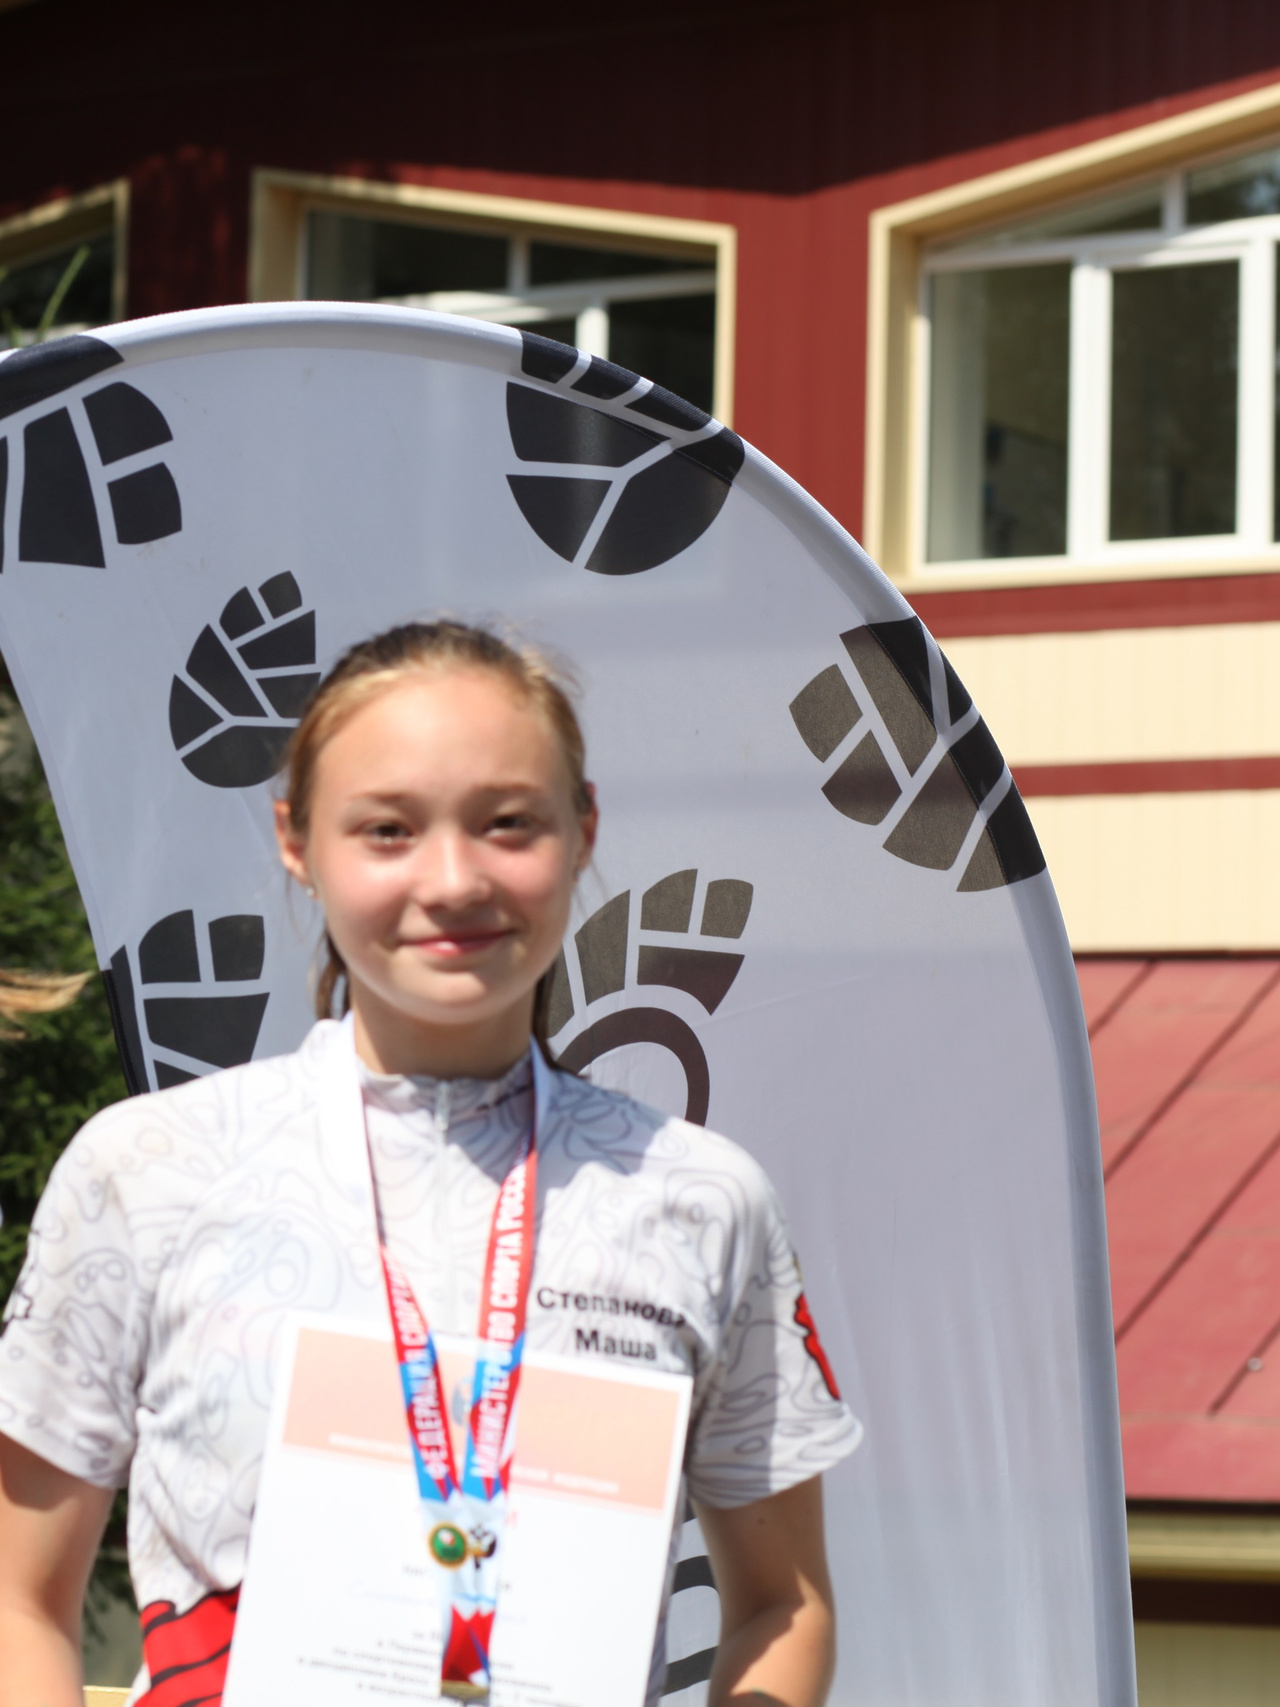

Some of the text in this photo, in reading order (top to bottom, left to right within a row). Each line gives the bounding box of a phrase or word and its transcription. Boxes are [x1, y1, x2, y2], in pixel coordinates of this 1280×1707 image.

[490, 1231, 524, 1309] СПОРТА
[575, 1328, 657, 1361] Маша
[404, 1347, 450, 1480] ФЕДЕРАЦИЯ
